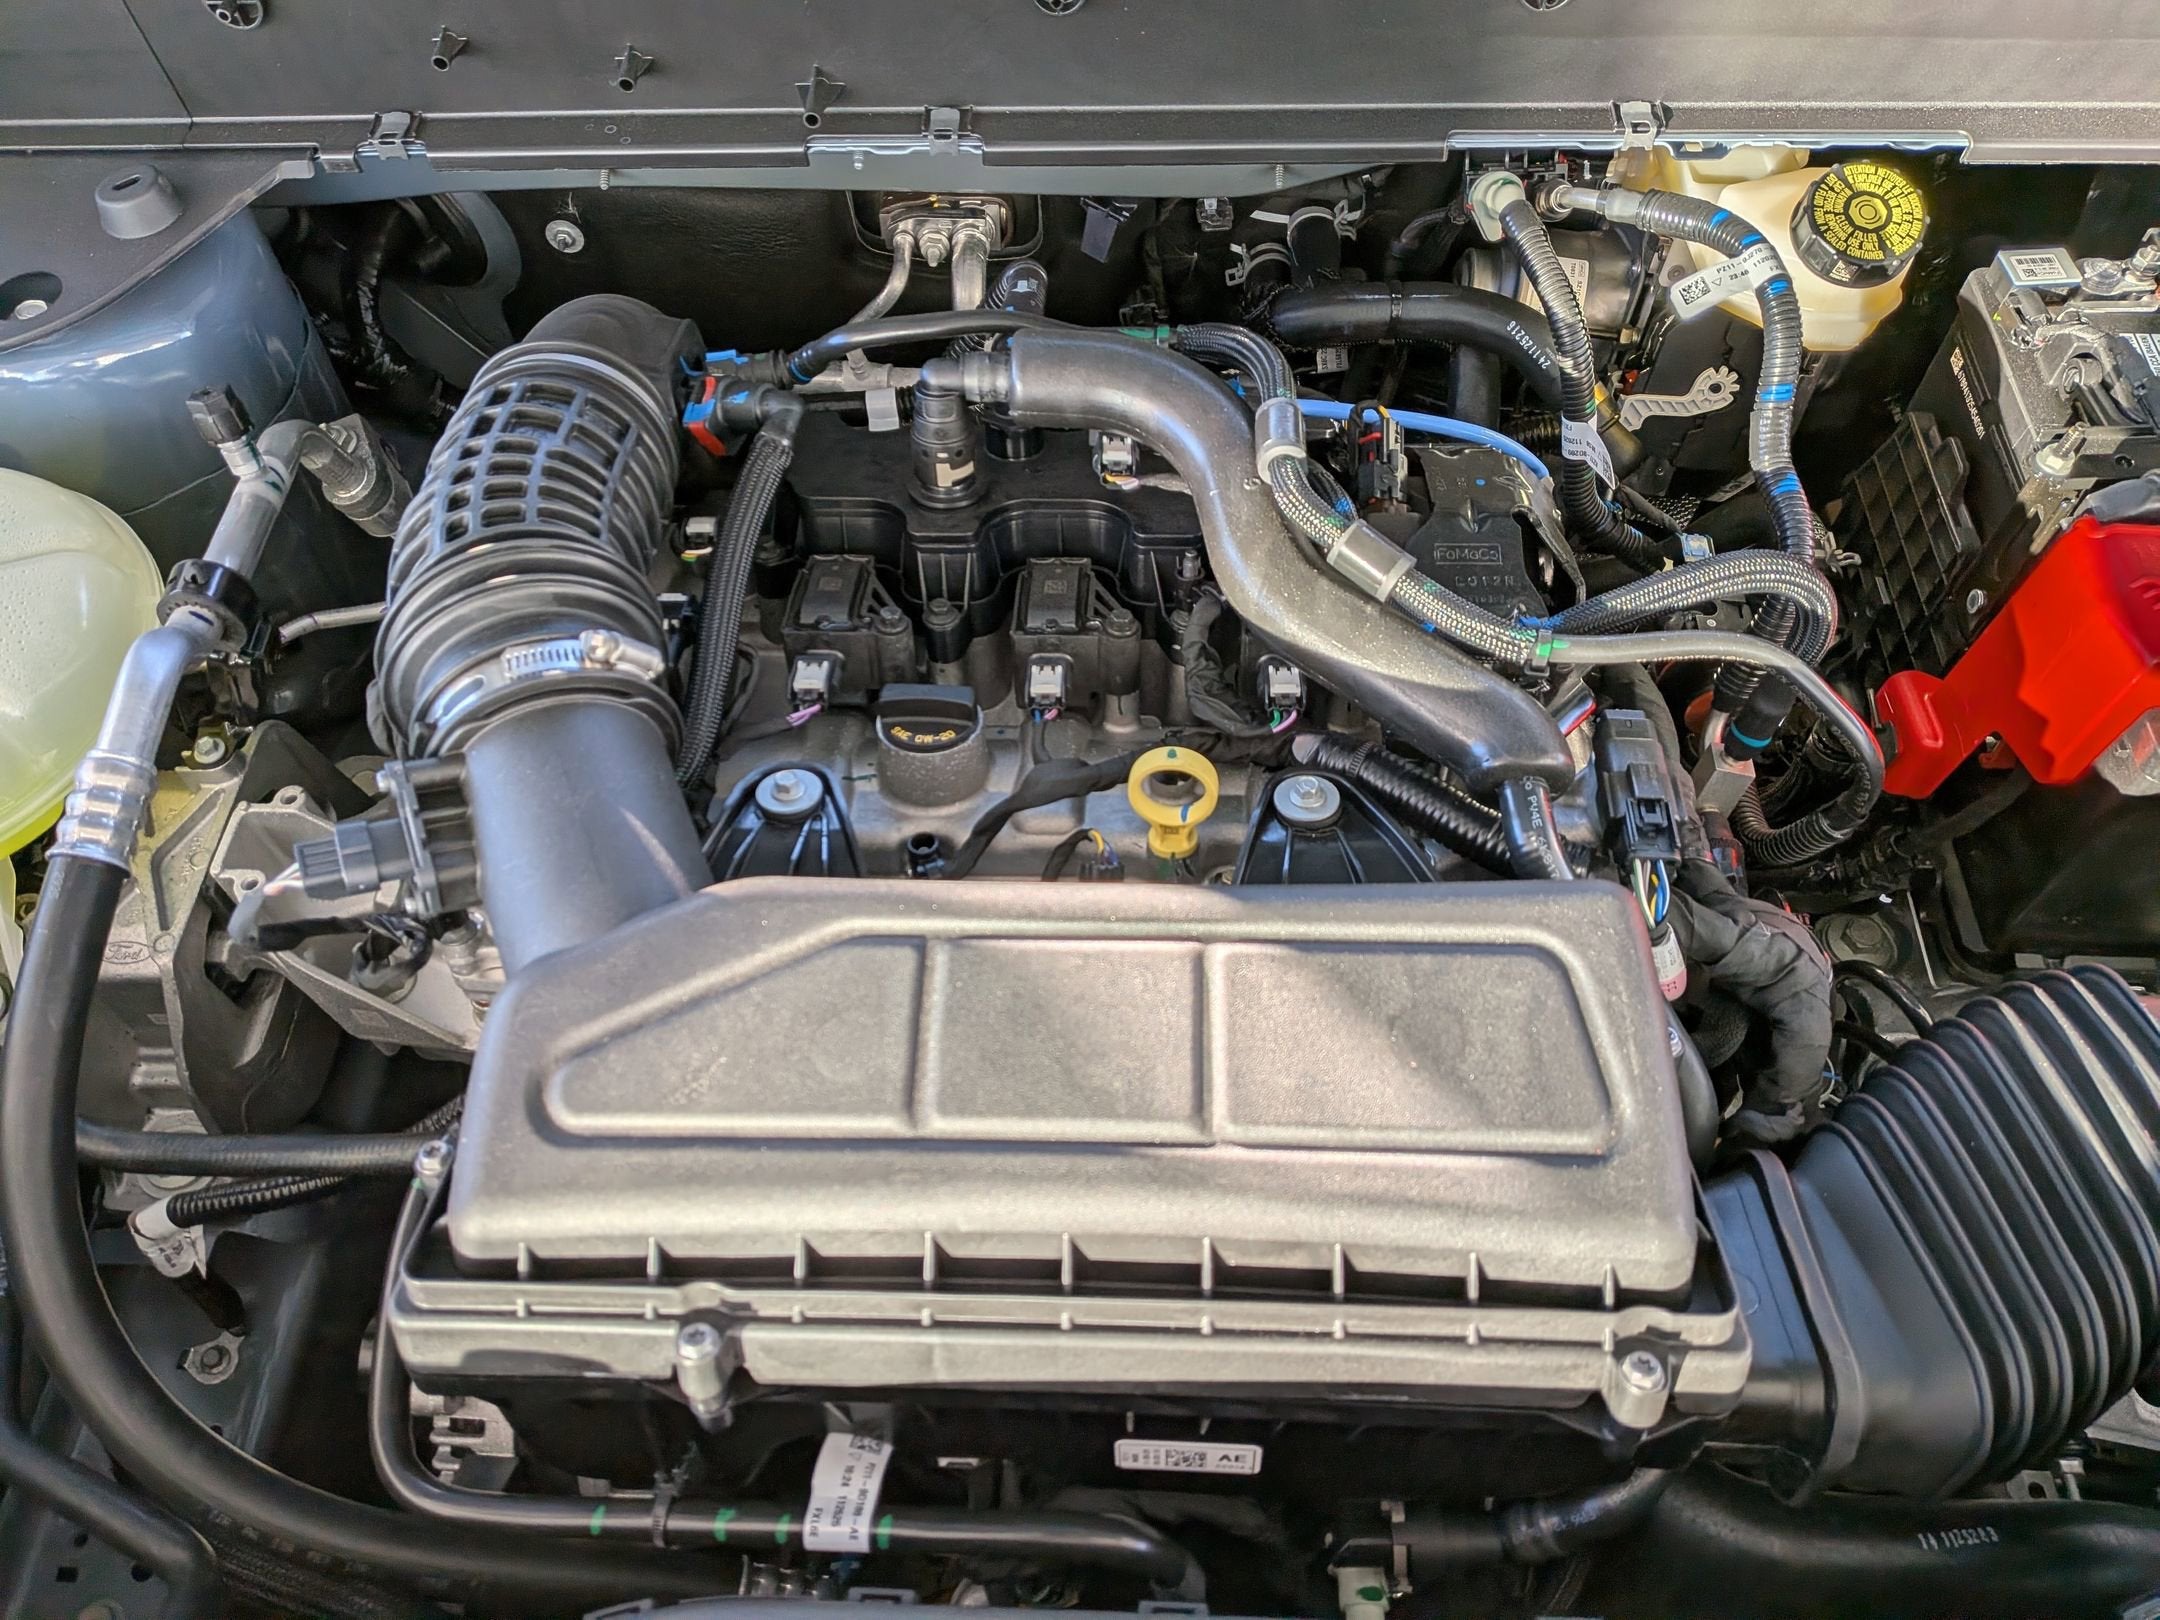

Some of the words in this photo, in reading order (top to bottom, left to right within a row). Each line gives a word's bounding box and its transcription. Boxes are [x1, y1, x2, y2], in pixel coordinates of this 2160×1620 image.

[1824, 172, 1838, 186] DOT
[1832, 179, 1846, 193] CAP
[1843, 164, 1876, 177] ATTENTION
[1877, 166, 1907, 189] NETTOYER
[1903, 184, 1915, 195] LE
[1813, 188, 1827, 207] FLUID
[1823, 189, 1837, 213] BEFORE
[1833, 187, 1854, 213] WARNING
[1813, 207, 1826, 225] FROM
[1836, 214, 1855, 234] CLEAN
[1825, 213, 1848, 241] REMOVING
[1823, 230, 1847, 252] SEALED
[1847, 237, 1861, 248] USE
[1853, 230, 1878, 243] FILLER
[1846, 247, 1885, 260] CONTAINER
[1861, 241, 1880, 252] ONLY
[890, 726, 913, 741] SAE
[105, 944, 143, 960] Ford
